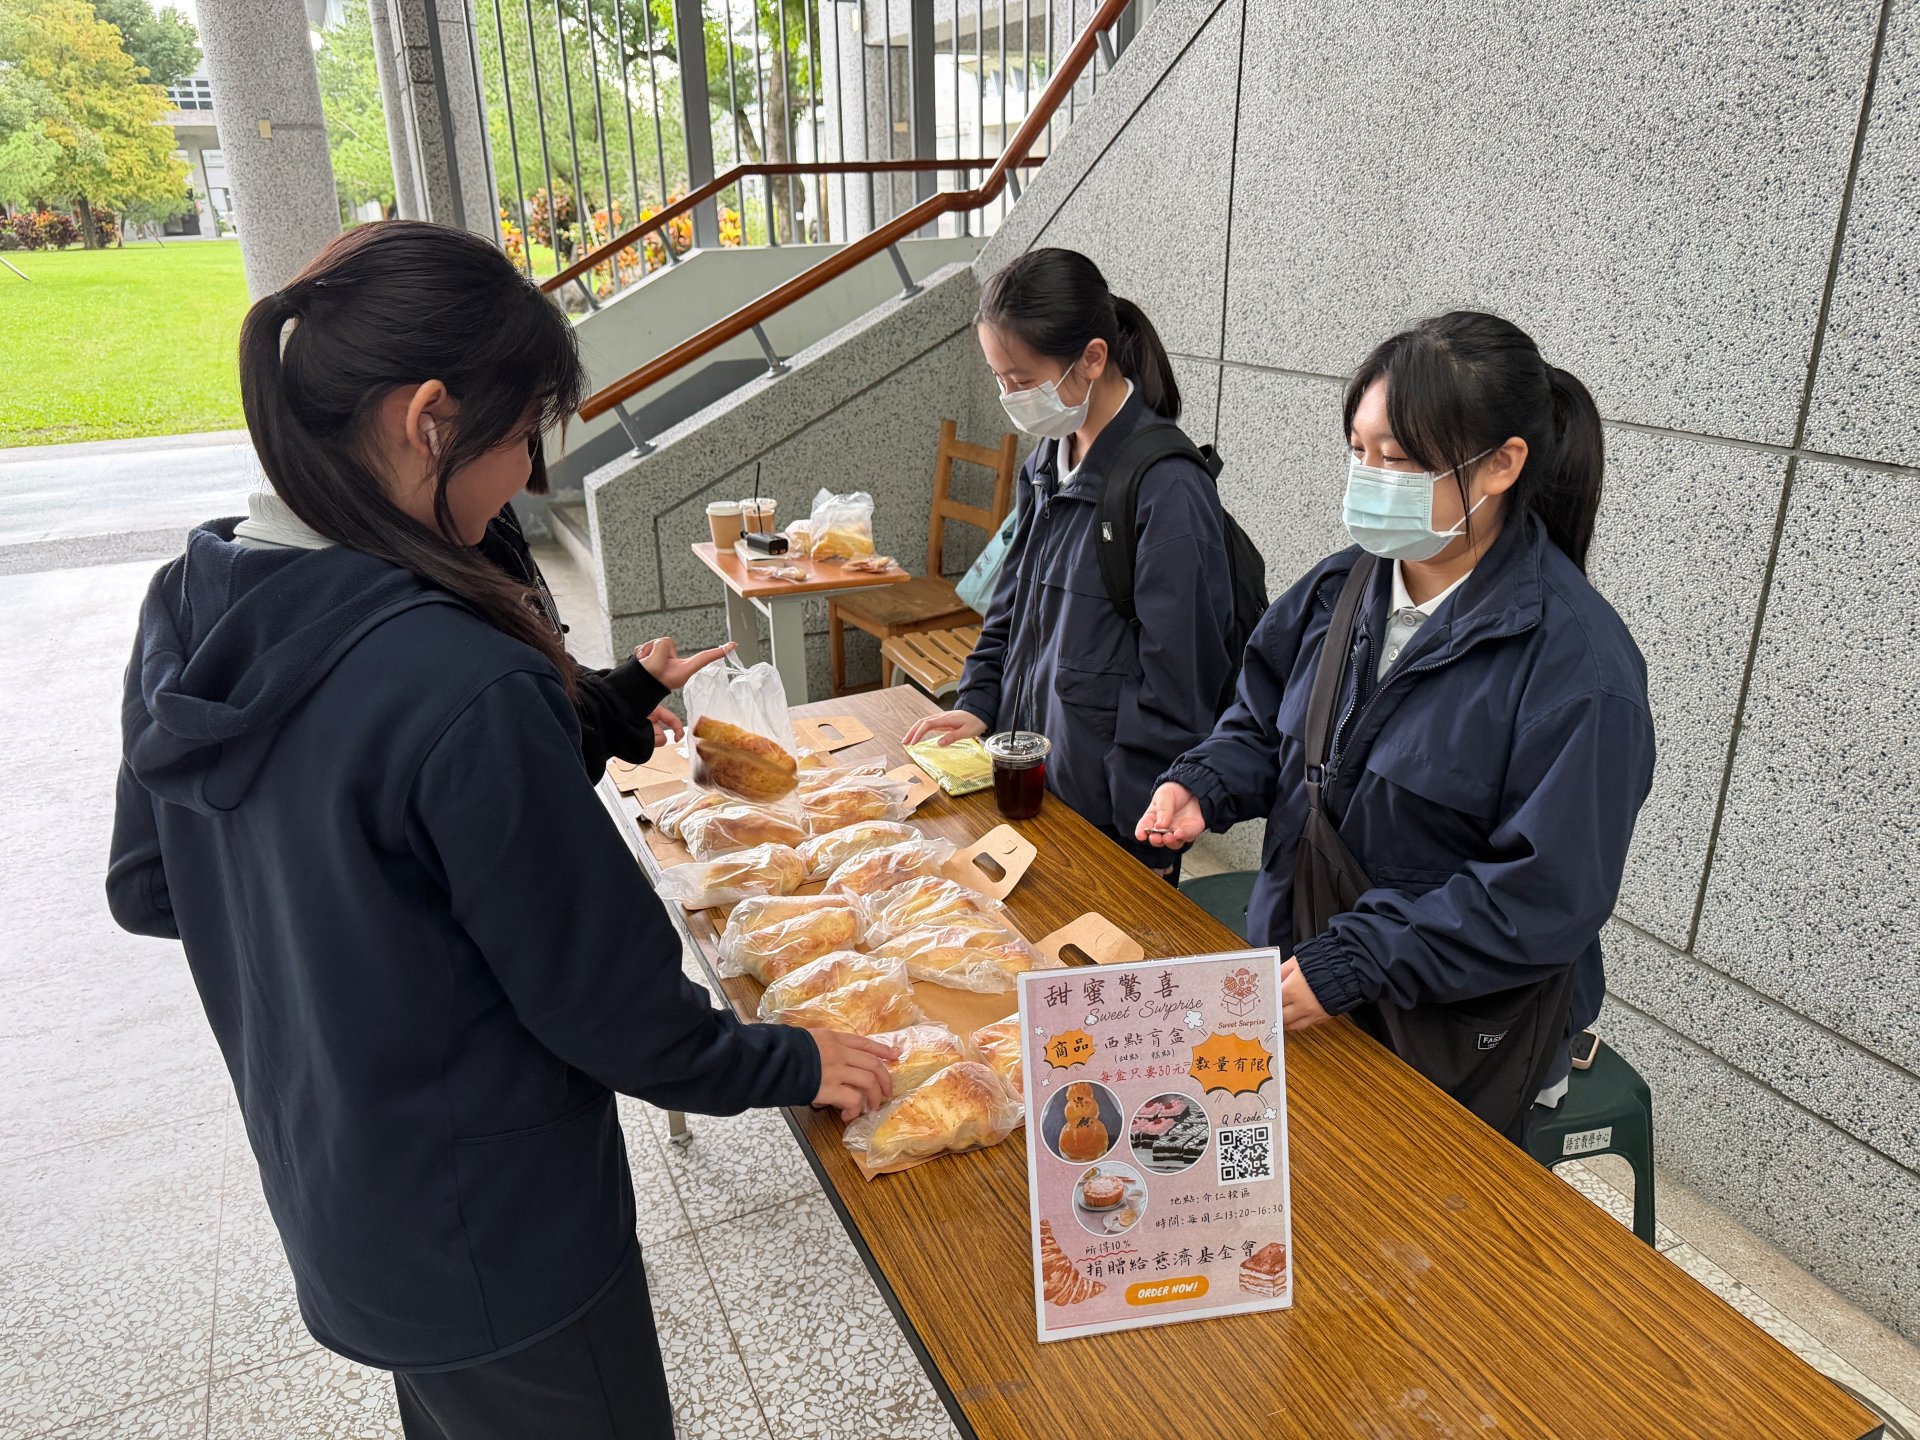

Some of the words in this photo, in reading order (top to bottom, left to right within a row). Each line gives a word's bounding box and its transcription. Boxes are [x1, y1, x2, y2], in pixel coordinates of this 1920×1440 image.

[1044, 970, 1180, 1008] 甜蜜驚喜
[1087, 1006, 1131, 1024] Sweet
[1139, 998, 1204, 1021] Surprise
[1218, 1020, 1237, 1029] Sweet
[1238, 1018, 1266, 1029] Surprise
[1052, 1038, 1090, 1058] 商品
[1104, 1027, 1186, 1049] 西點盲盒
[1099, 1063, 1186, 1083] 每盒只要30元
[1195, 1056, 1266, 1073] 數量有限
[1086, 1239, 1258, 1277] 捐贈給慈濟基金會
[1137, 1283, 1169, 1299] ORDER
[1171, 1281, 1199, 1295] NOW!
